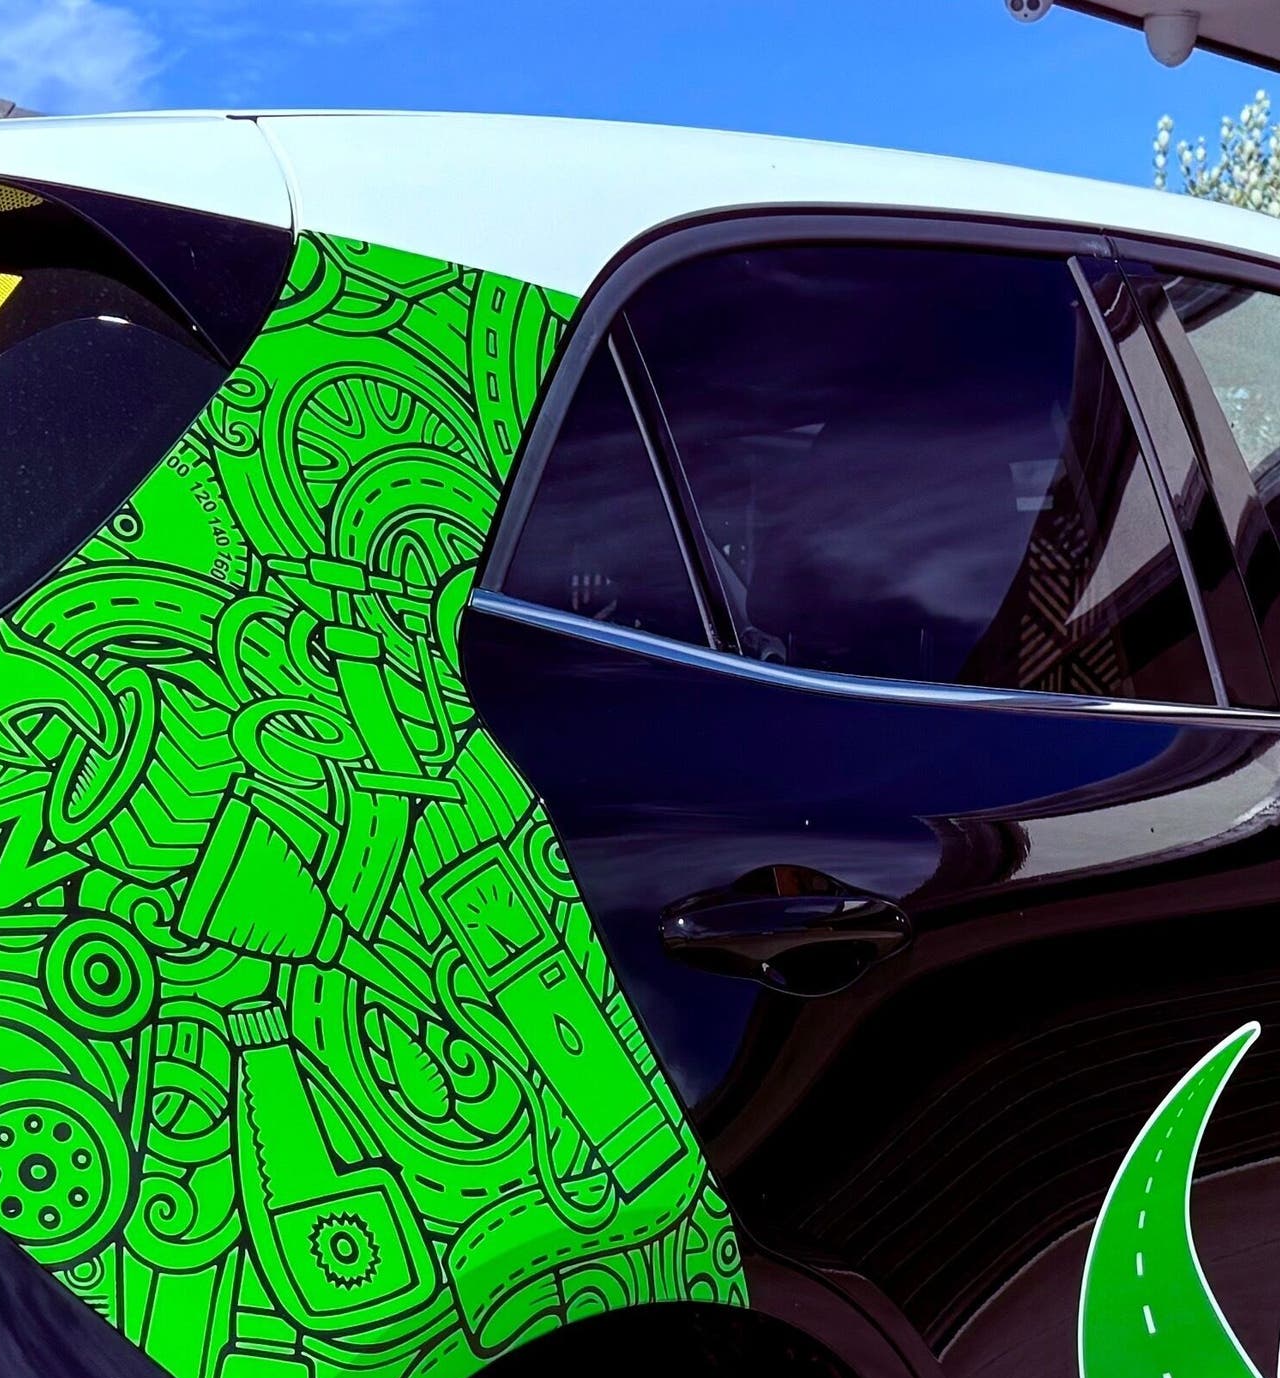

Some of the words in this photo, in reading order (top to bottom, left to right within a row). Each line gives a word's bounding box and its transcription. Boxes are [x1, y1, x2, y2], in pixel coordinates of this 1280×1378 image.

[190, 481, 217, 512] 120
[208, 517, 230, 546] 140
[210, 551, 233, 580] 160
